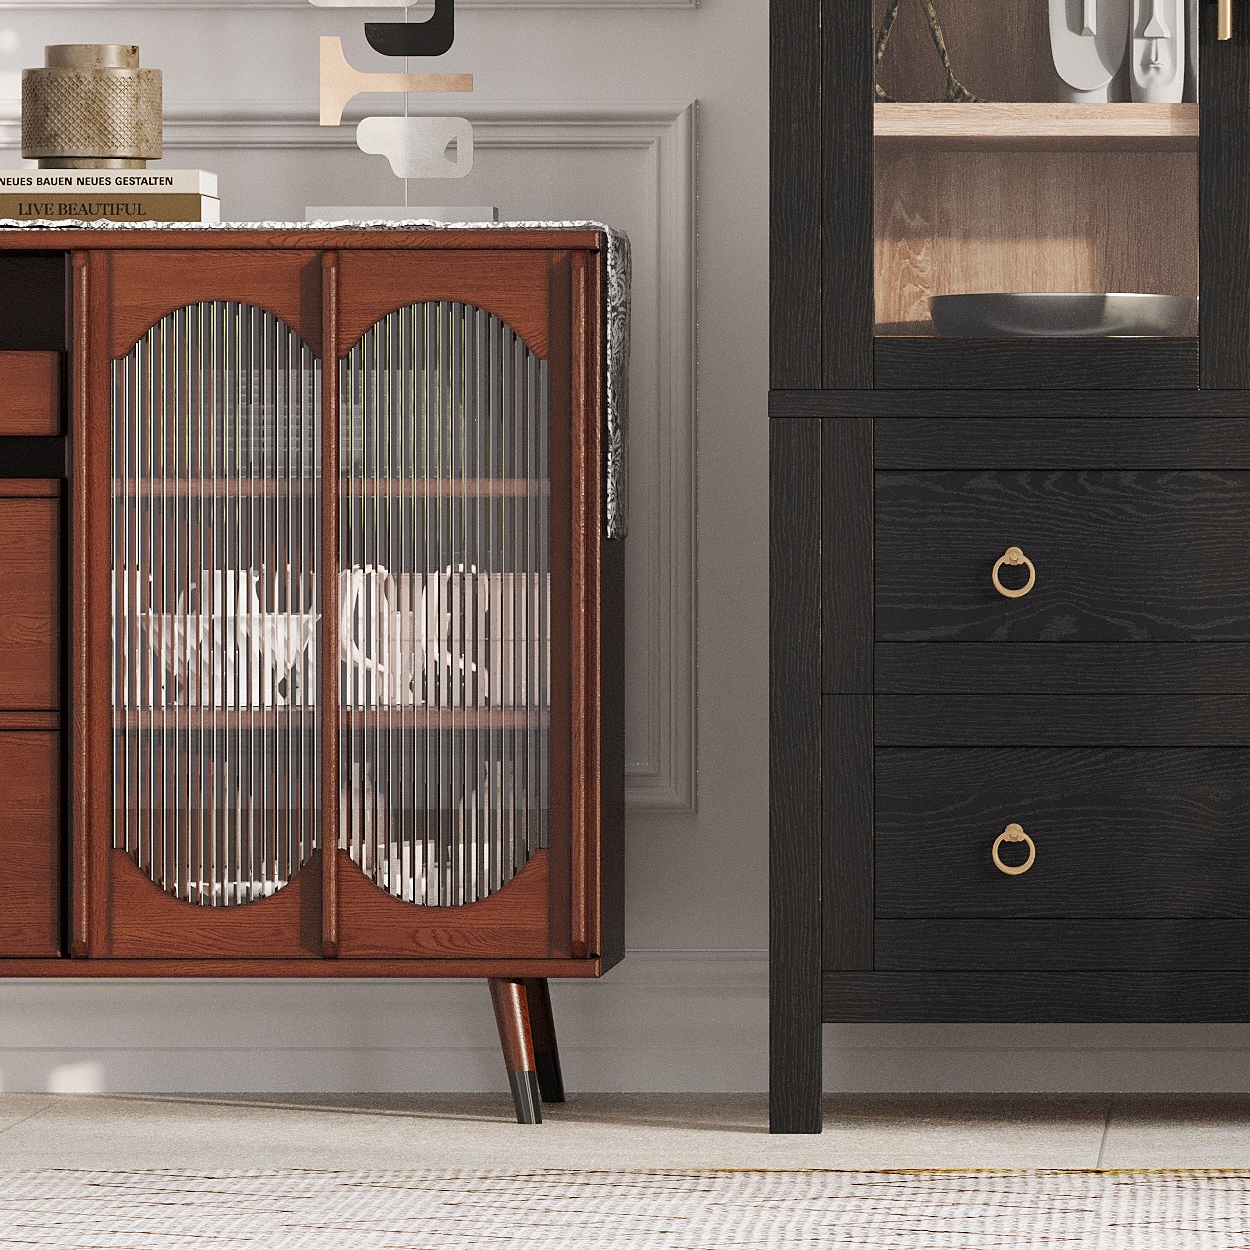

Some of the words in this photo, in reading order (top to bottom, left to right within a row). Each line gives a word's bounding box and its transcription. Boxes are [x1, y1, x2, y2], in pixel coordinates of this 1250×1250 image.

[0, 177, 32, 186] NEUES
[36, 177, 72, 186] BAUEN
[77, 177, 111, 186] NEUES
[115, 177, 173, 186] GESTALTEN
[18, 203, 54, 216] LIVE
[58, 203, 146, 216] BEAUTIFUL
